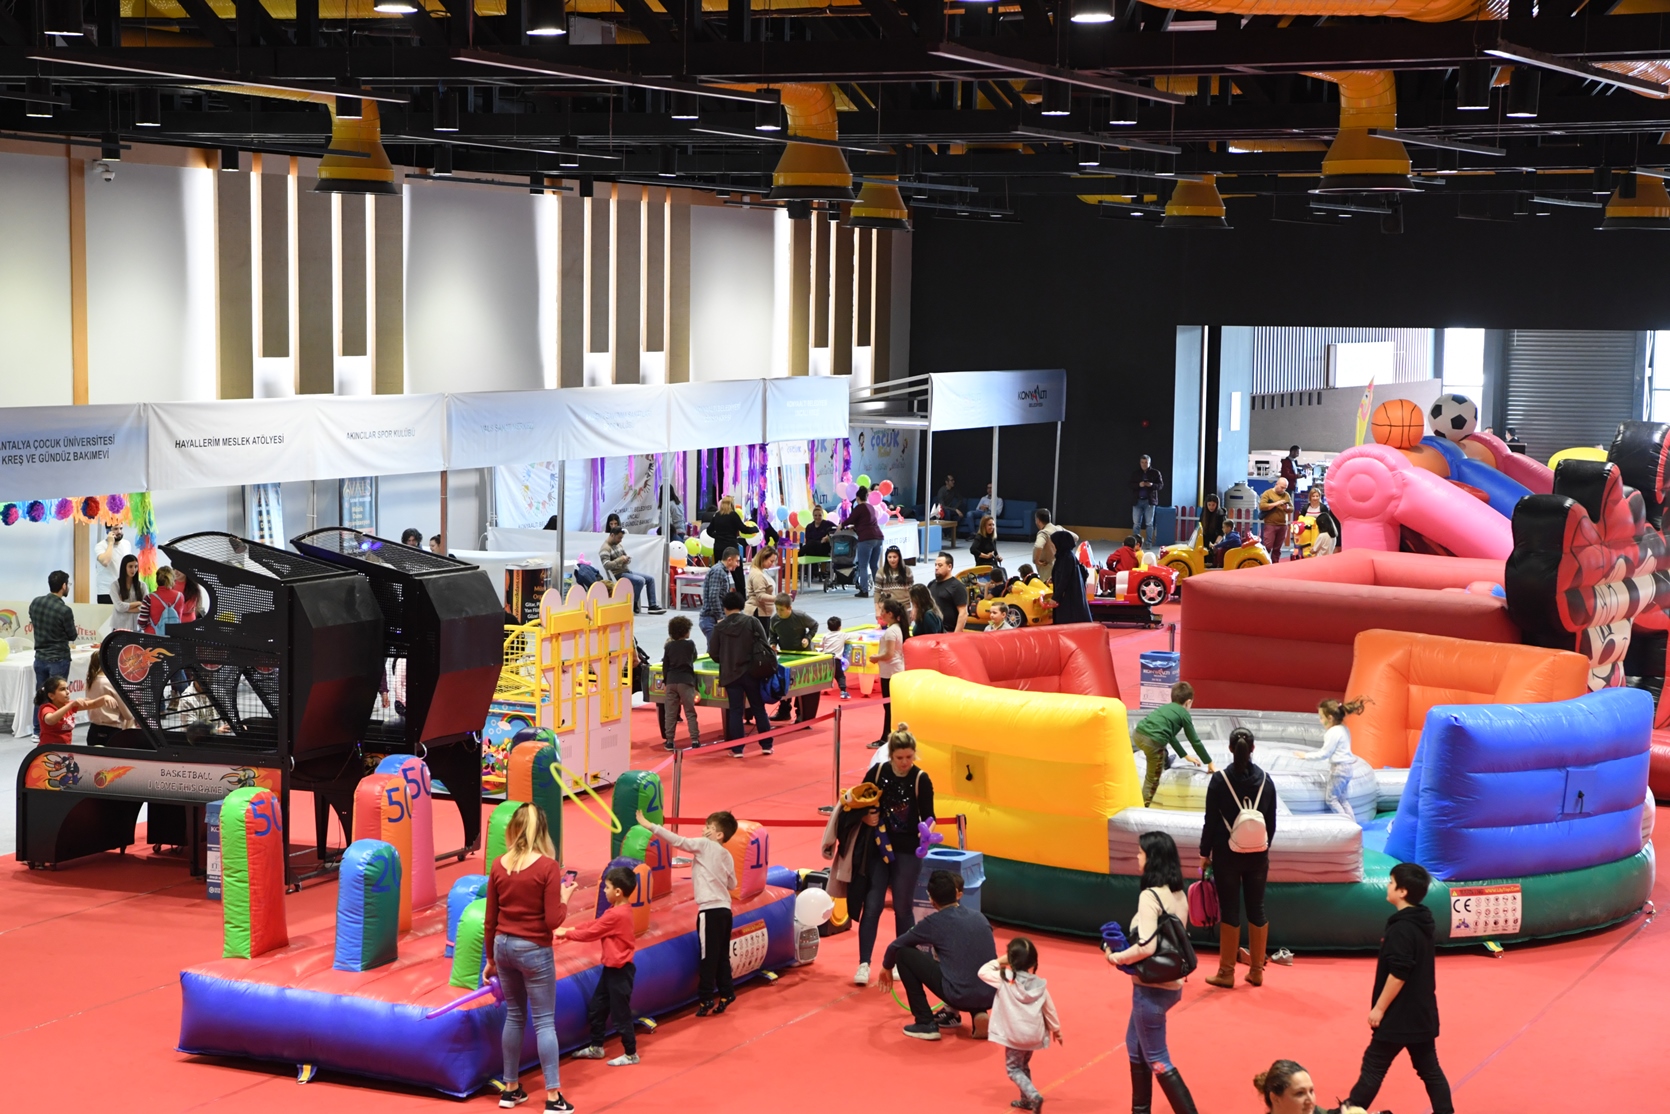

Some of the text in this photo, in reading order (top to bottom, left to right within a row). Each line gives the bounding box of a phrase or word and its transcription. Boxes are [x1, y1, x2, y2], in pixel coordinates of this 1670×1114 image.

[175, 433, 285, 449] HAYALLERİM MESLEK ATÖLYESİ
[346, 427, 415, 440] AKINCILAR SPOR KULÜBÜ
[33, 438, 61, 452] ÇOCUK
[63, 434, 116, 448] ÜNİVERSİTESİ
[1, 448, 110, 466] KREŞ VE GÜNDÜZ BAKIMEVİ
[348, 480, 371, 496] VALS
[160, 768, 213, 781] BASKETBALL
[155, 781, 176, 791] LOVE
[178, 783, 196, 792] THIS
[197, 785, 224, 794] GAME
